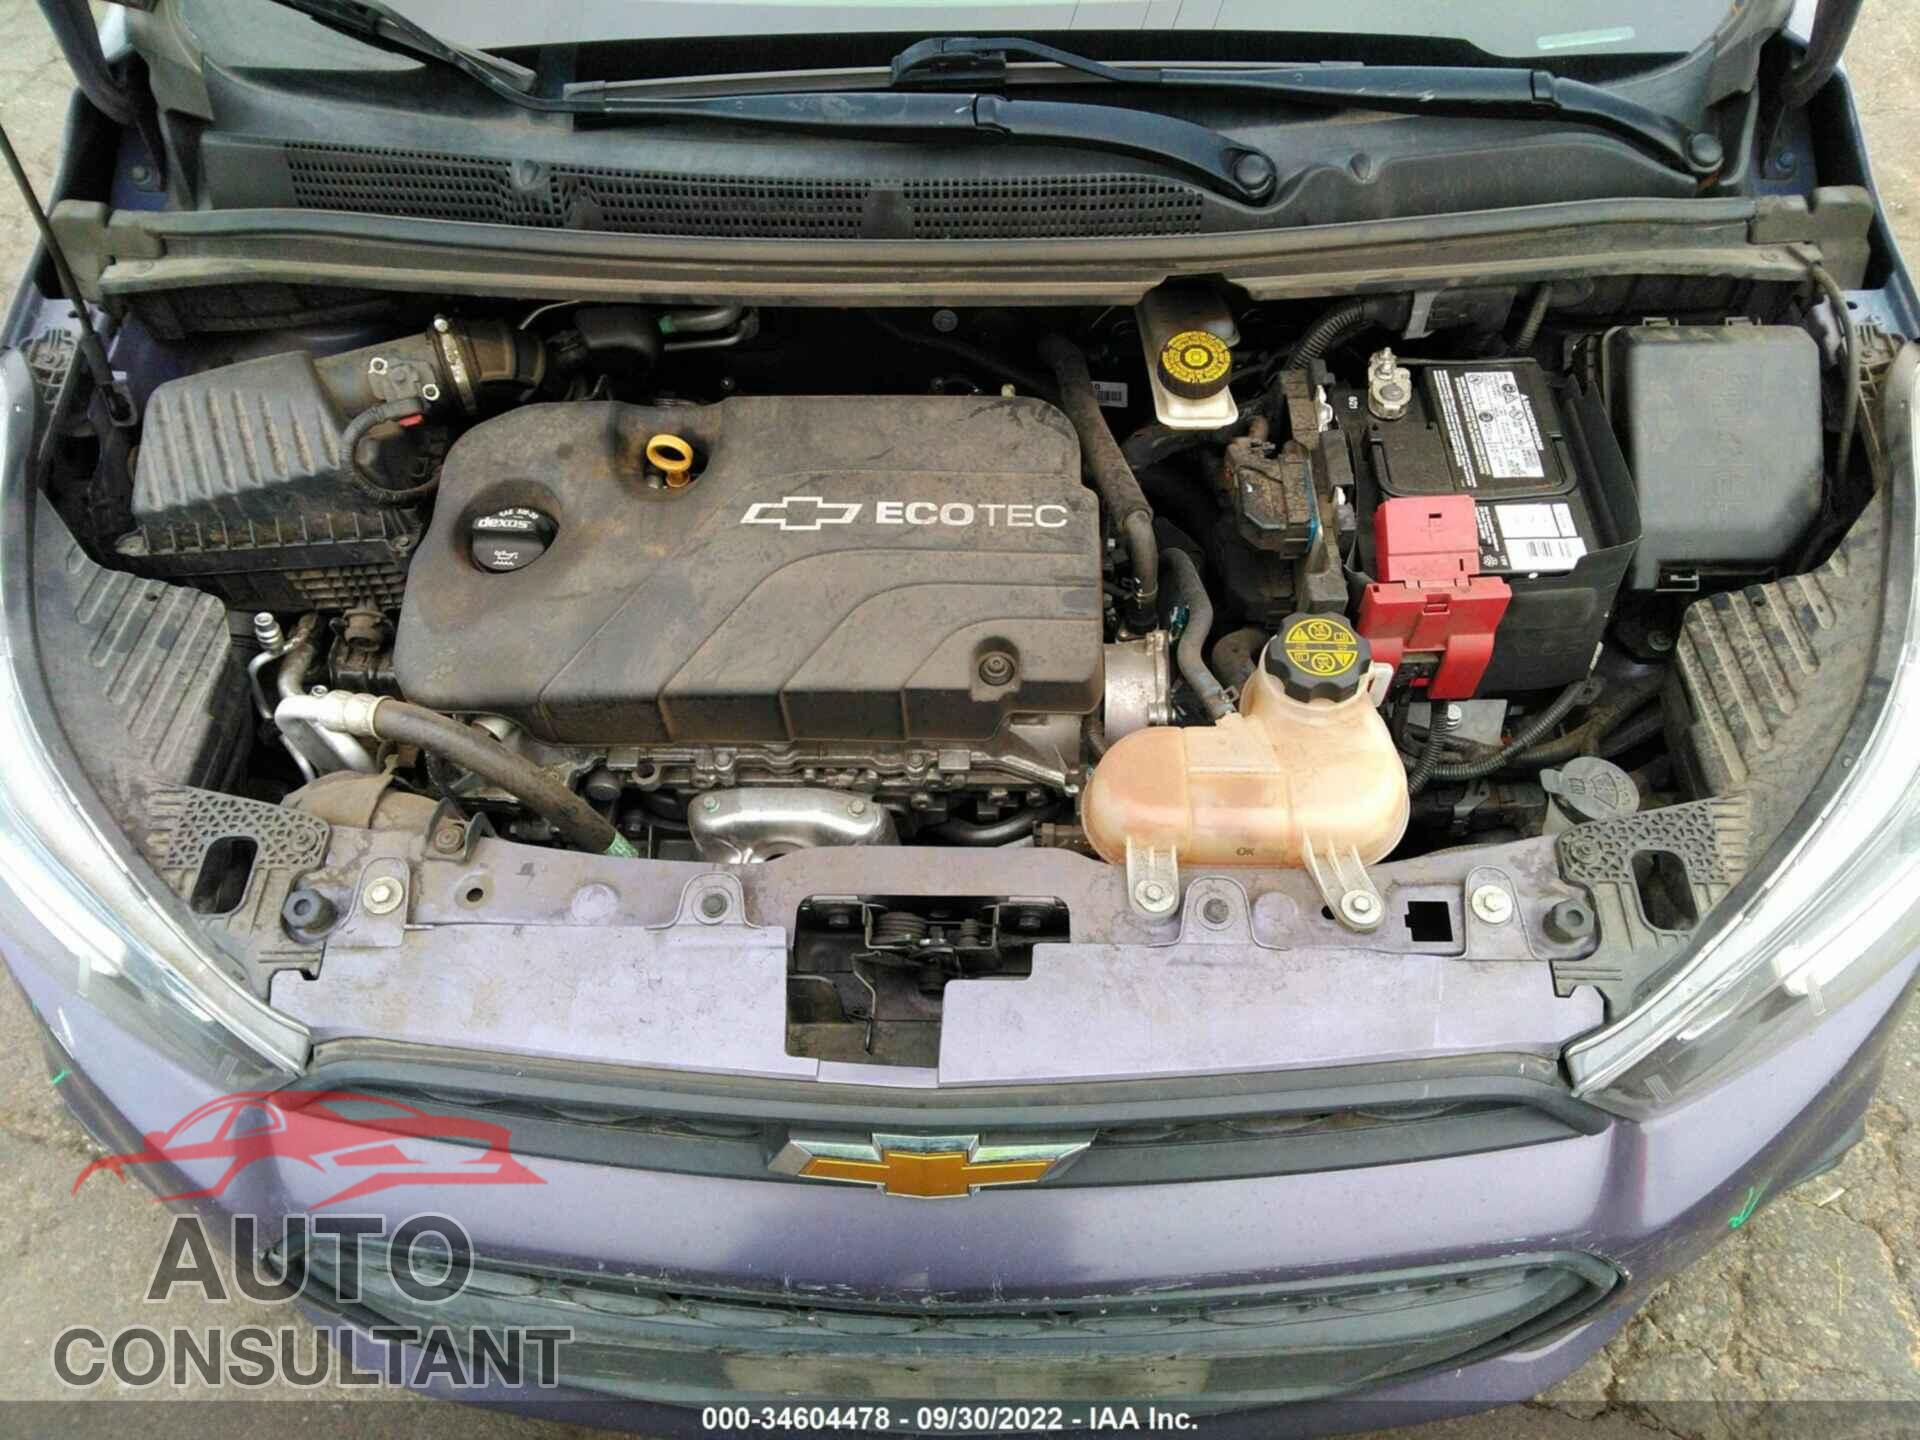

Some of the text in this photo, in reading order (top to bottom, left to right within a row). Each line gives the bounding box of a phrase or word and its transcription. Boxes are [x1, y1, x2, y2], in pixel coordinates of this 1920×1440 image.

[875, 501, 1068, 528] ECOTEC
[477, 516, 529, 529] dexos
[1236, 847, 1255, 856] OK
